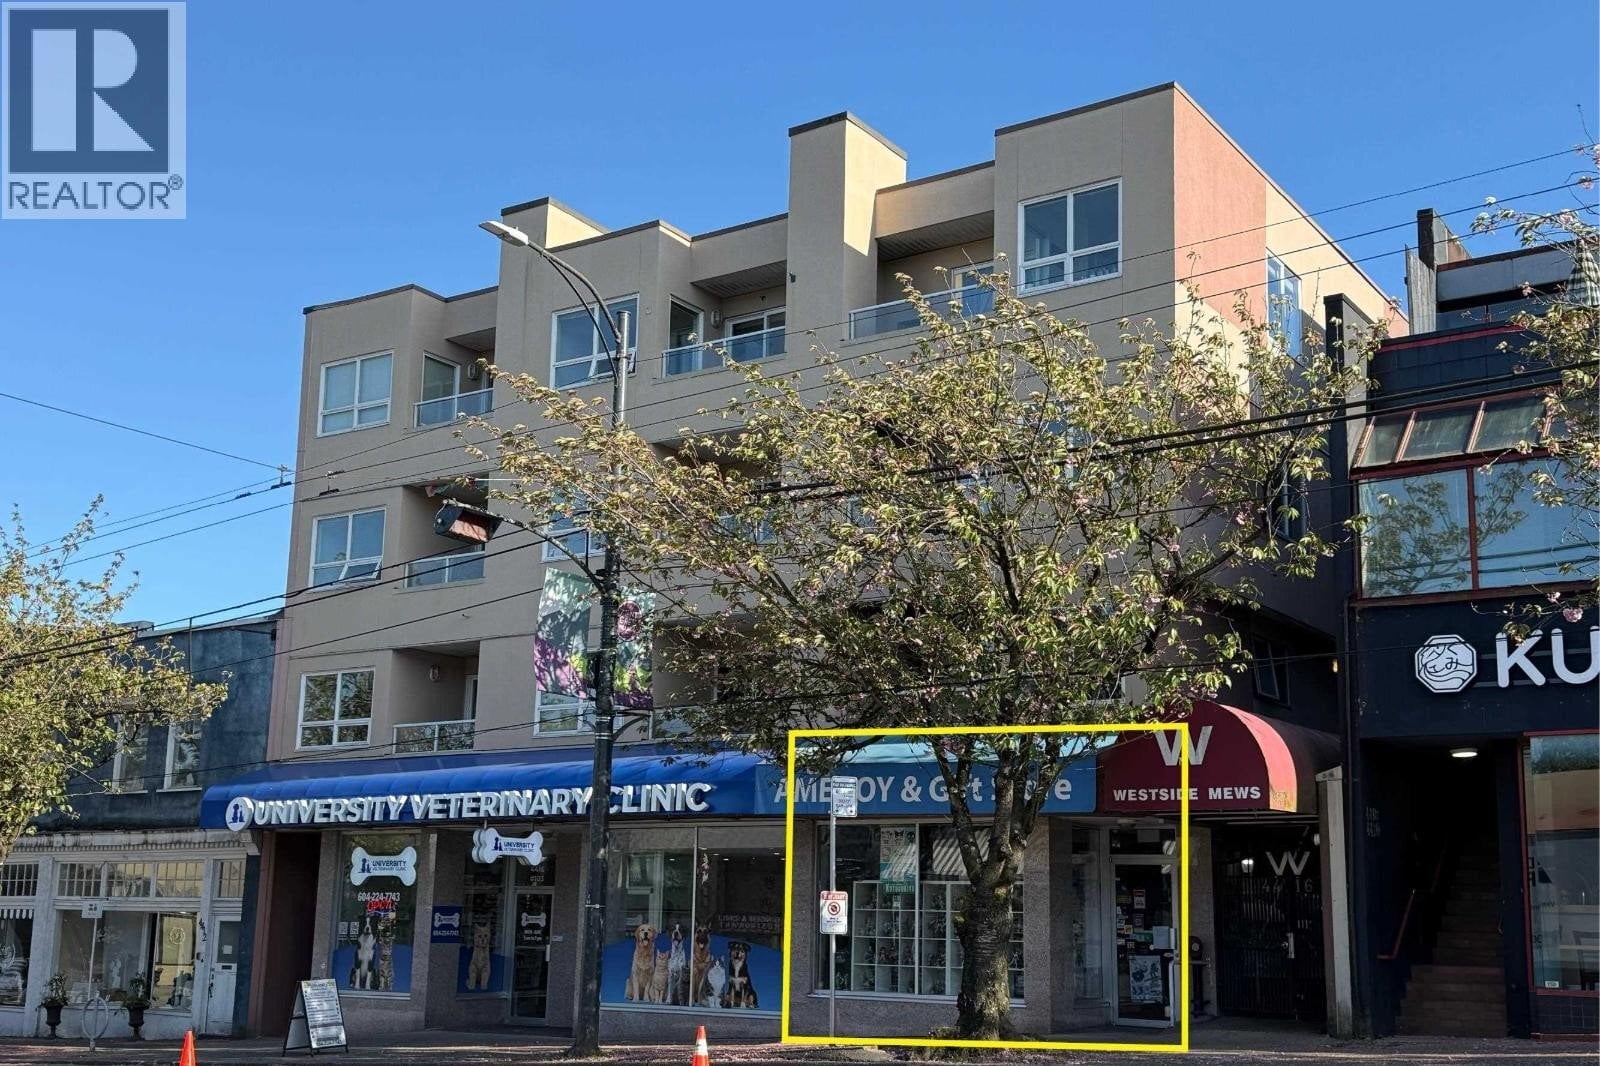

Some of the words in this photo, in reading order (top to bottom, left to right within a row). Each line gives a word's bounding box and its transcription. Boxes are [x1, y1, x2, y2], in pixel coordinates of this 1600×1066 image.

[1495, 625, 1600, 688] KU
[1154, 726, 1214, 767] W
[901, 775, 922, 802] &
[929, 774, 983, 802] Gt
[1208, 786, 1261, 800] MEWS
[253, 794, 408, 826] UNIVERSITY
[410, 785, 593, 821] VETERINARY
[608, 782, 713, 815] CLINIC
[503, 841, 535, 849] UNIVERSITY
[1265, 851, 1311, 876] W
